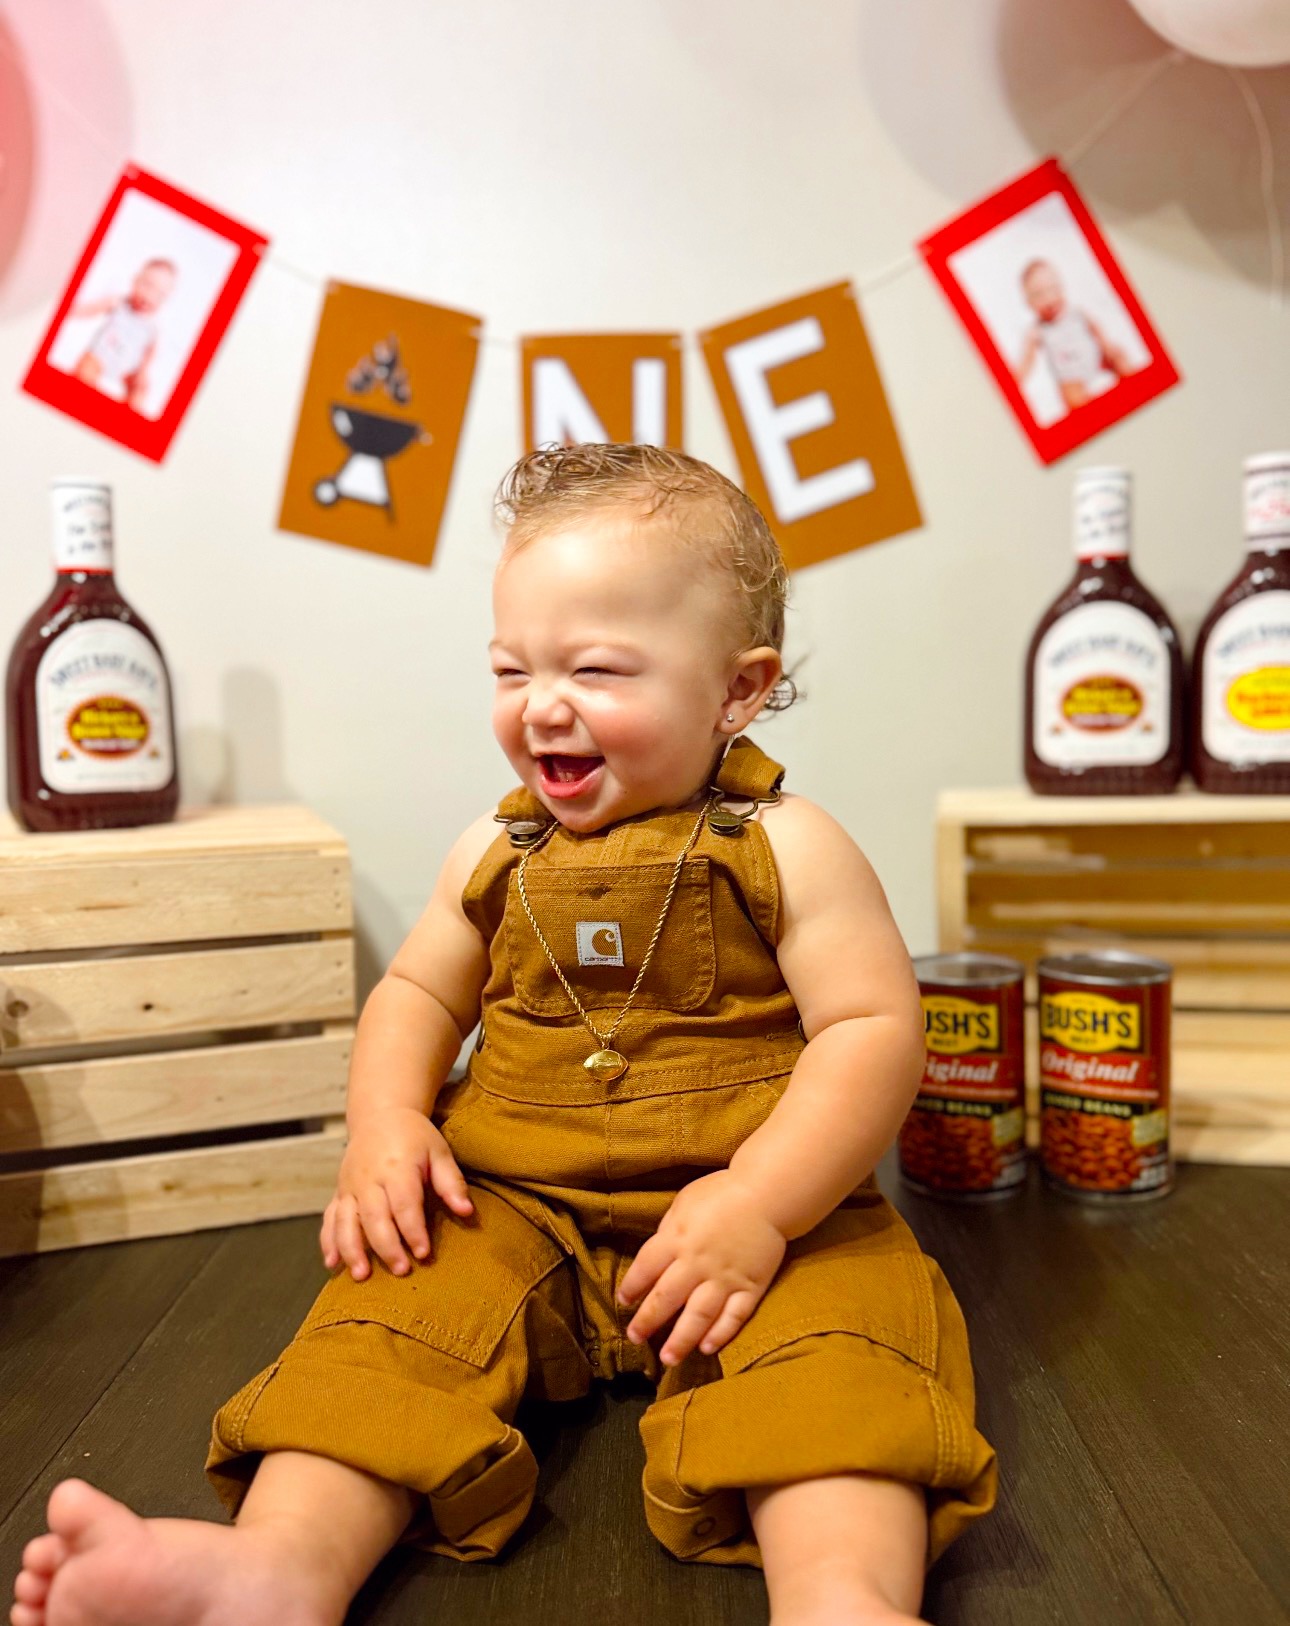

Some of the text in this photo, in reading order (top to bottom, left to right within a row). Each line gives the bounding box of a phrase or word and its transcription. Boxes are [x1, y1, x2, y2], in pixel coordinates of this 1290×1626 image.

[1046, 1003, 1132, 1039] BUSH'S
[926, 1055, 999, 1083] iginal
[1041, 1047, 1139, 1083] Original
